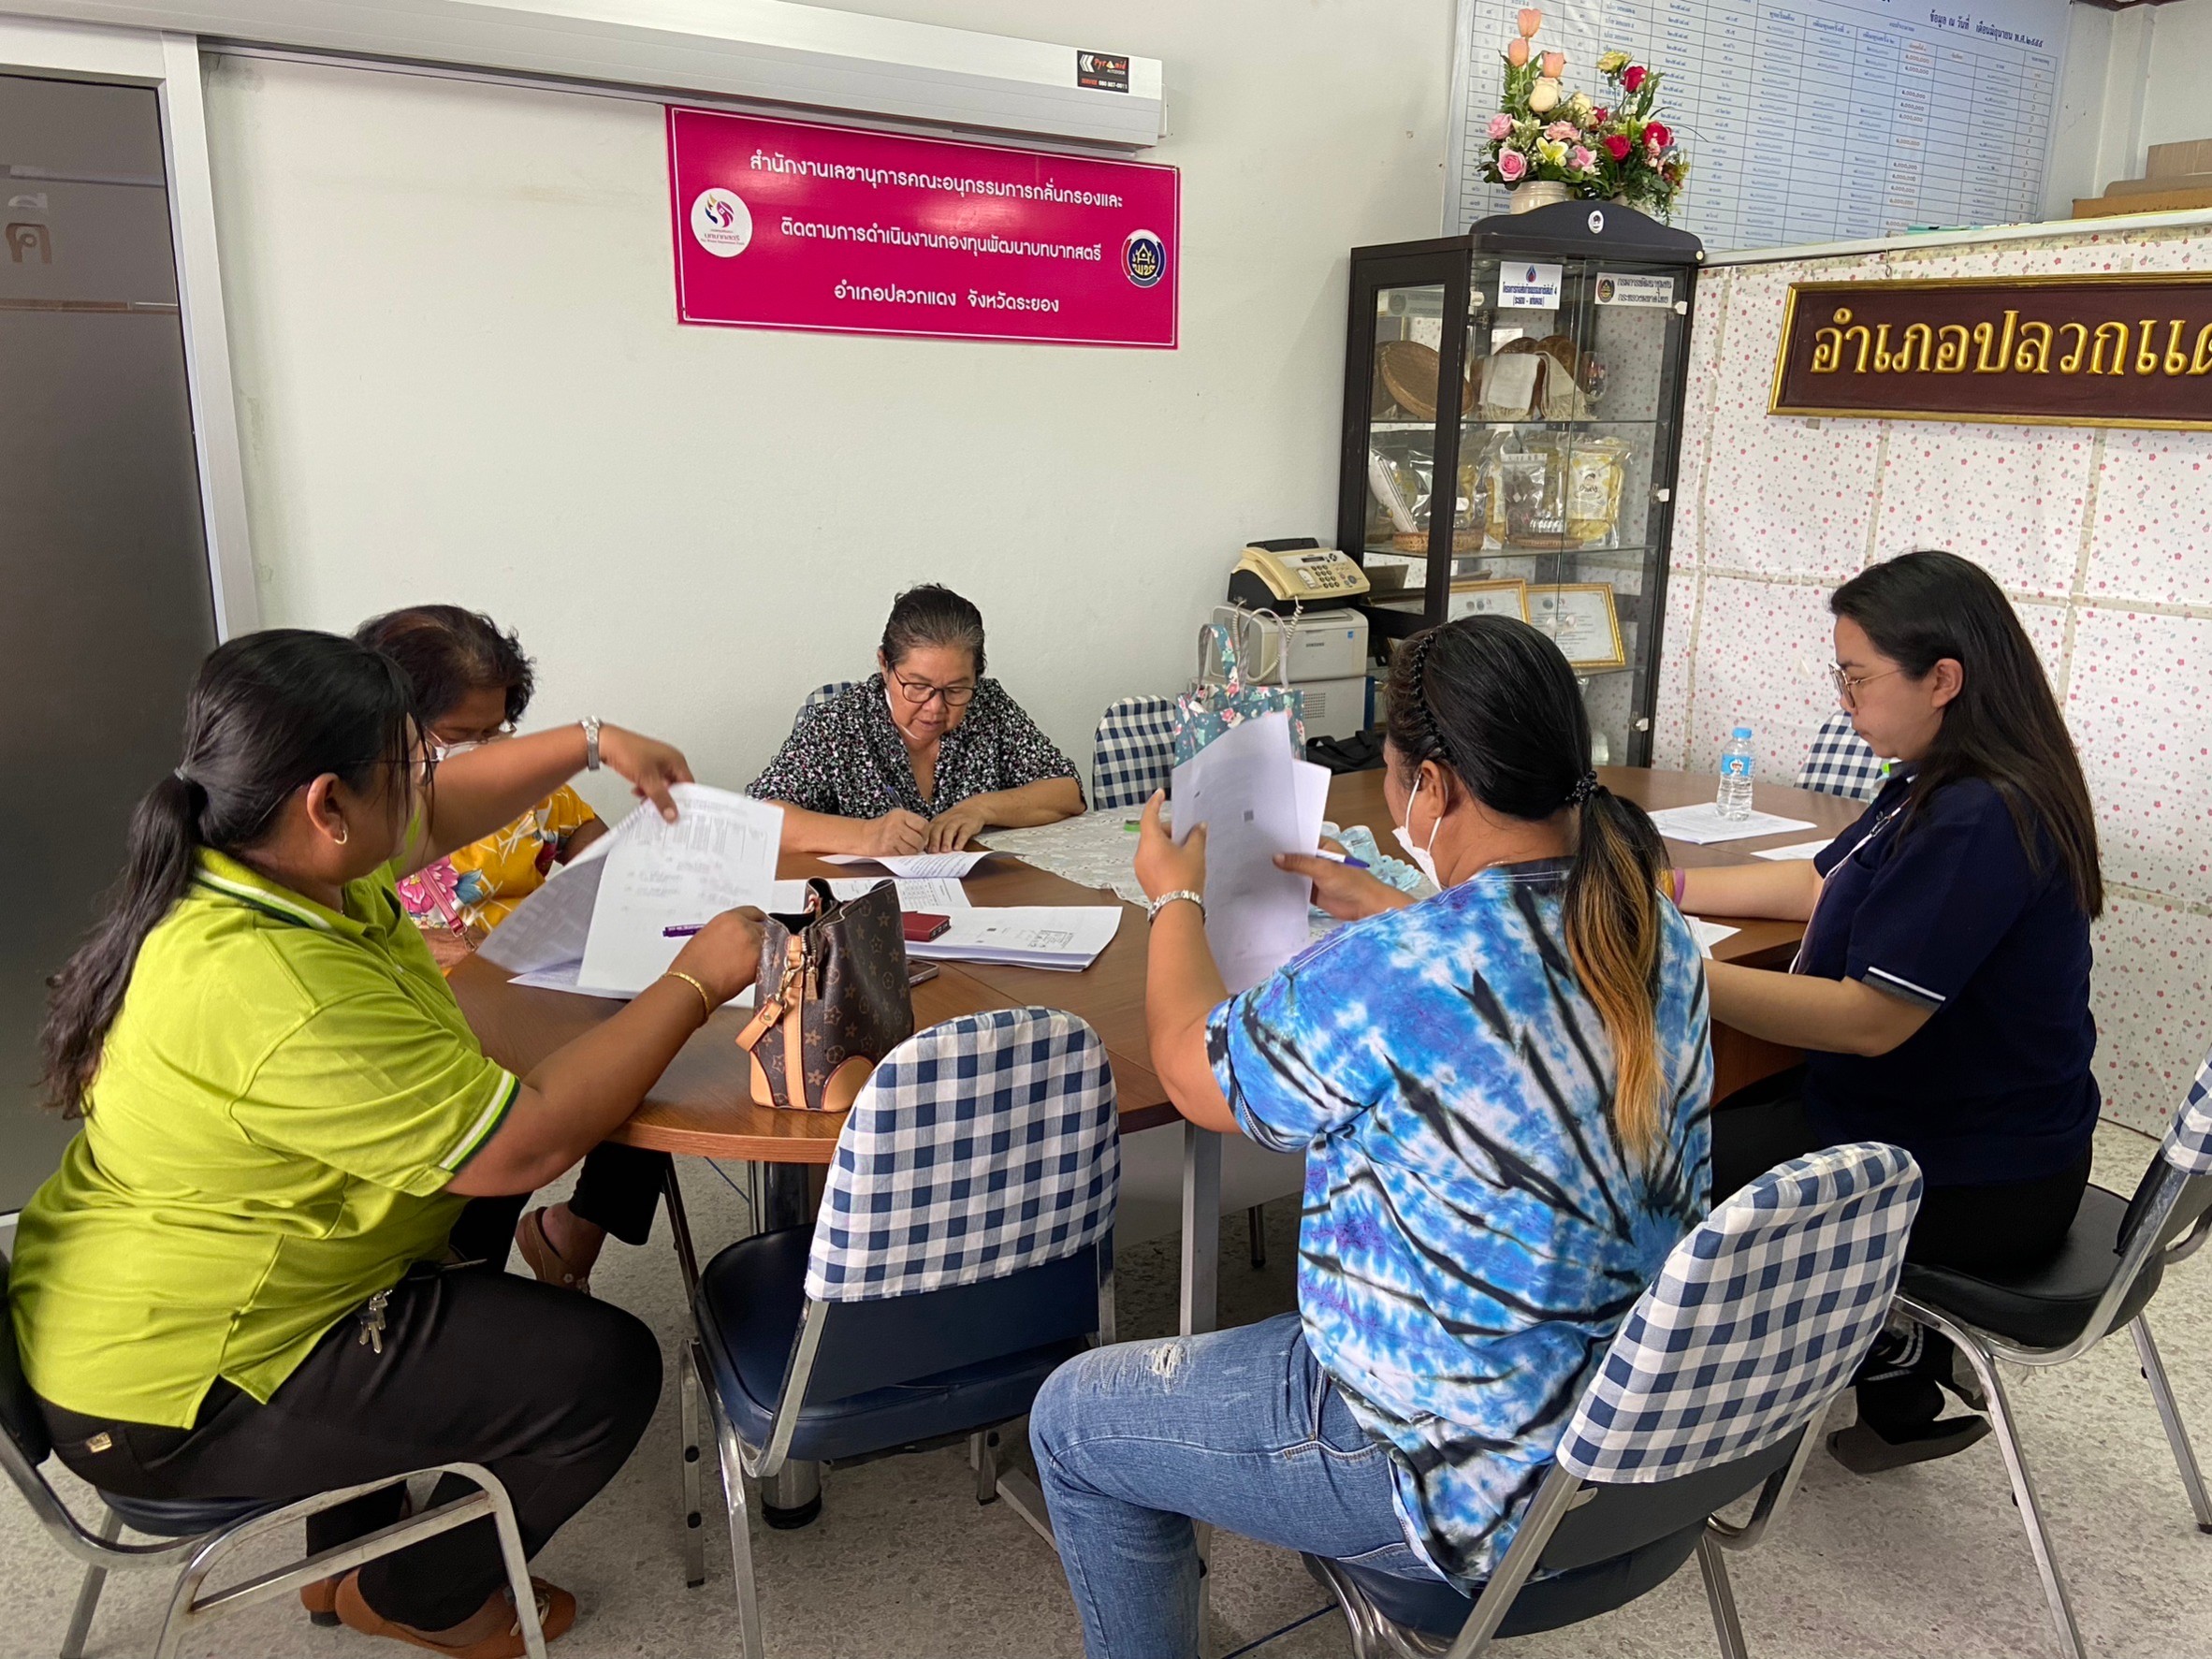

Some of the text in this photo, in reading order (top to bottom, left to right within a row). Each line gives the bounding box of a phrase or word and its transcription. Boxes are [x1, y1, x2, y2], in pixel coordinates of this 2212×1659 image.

[749, 149, 1123, 208] สำนักงานเลขานุการคณะอนุกรรมการกลั่นกรองและ
[780, 216, 1101, 261] ติดตามการดำเนินงานกองทุนพัฒนาบทบาทสตรี
[834, 279, 1059, 313] อำเภอปลวกแดง จังหวัดระยอง
